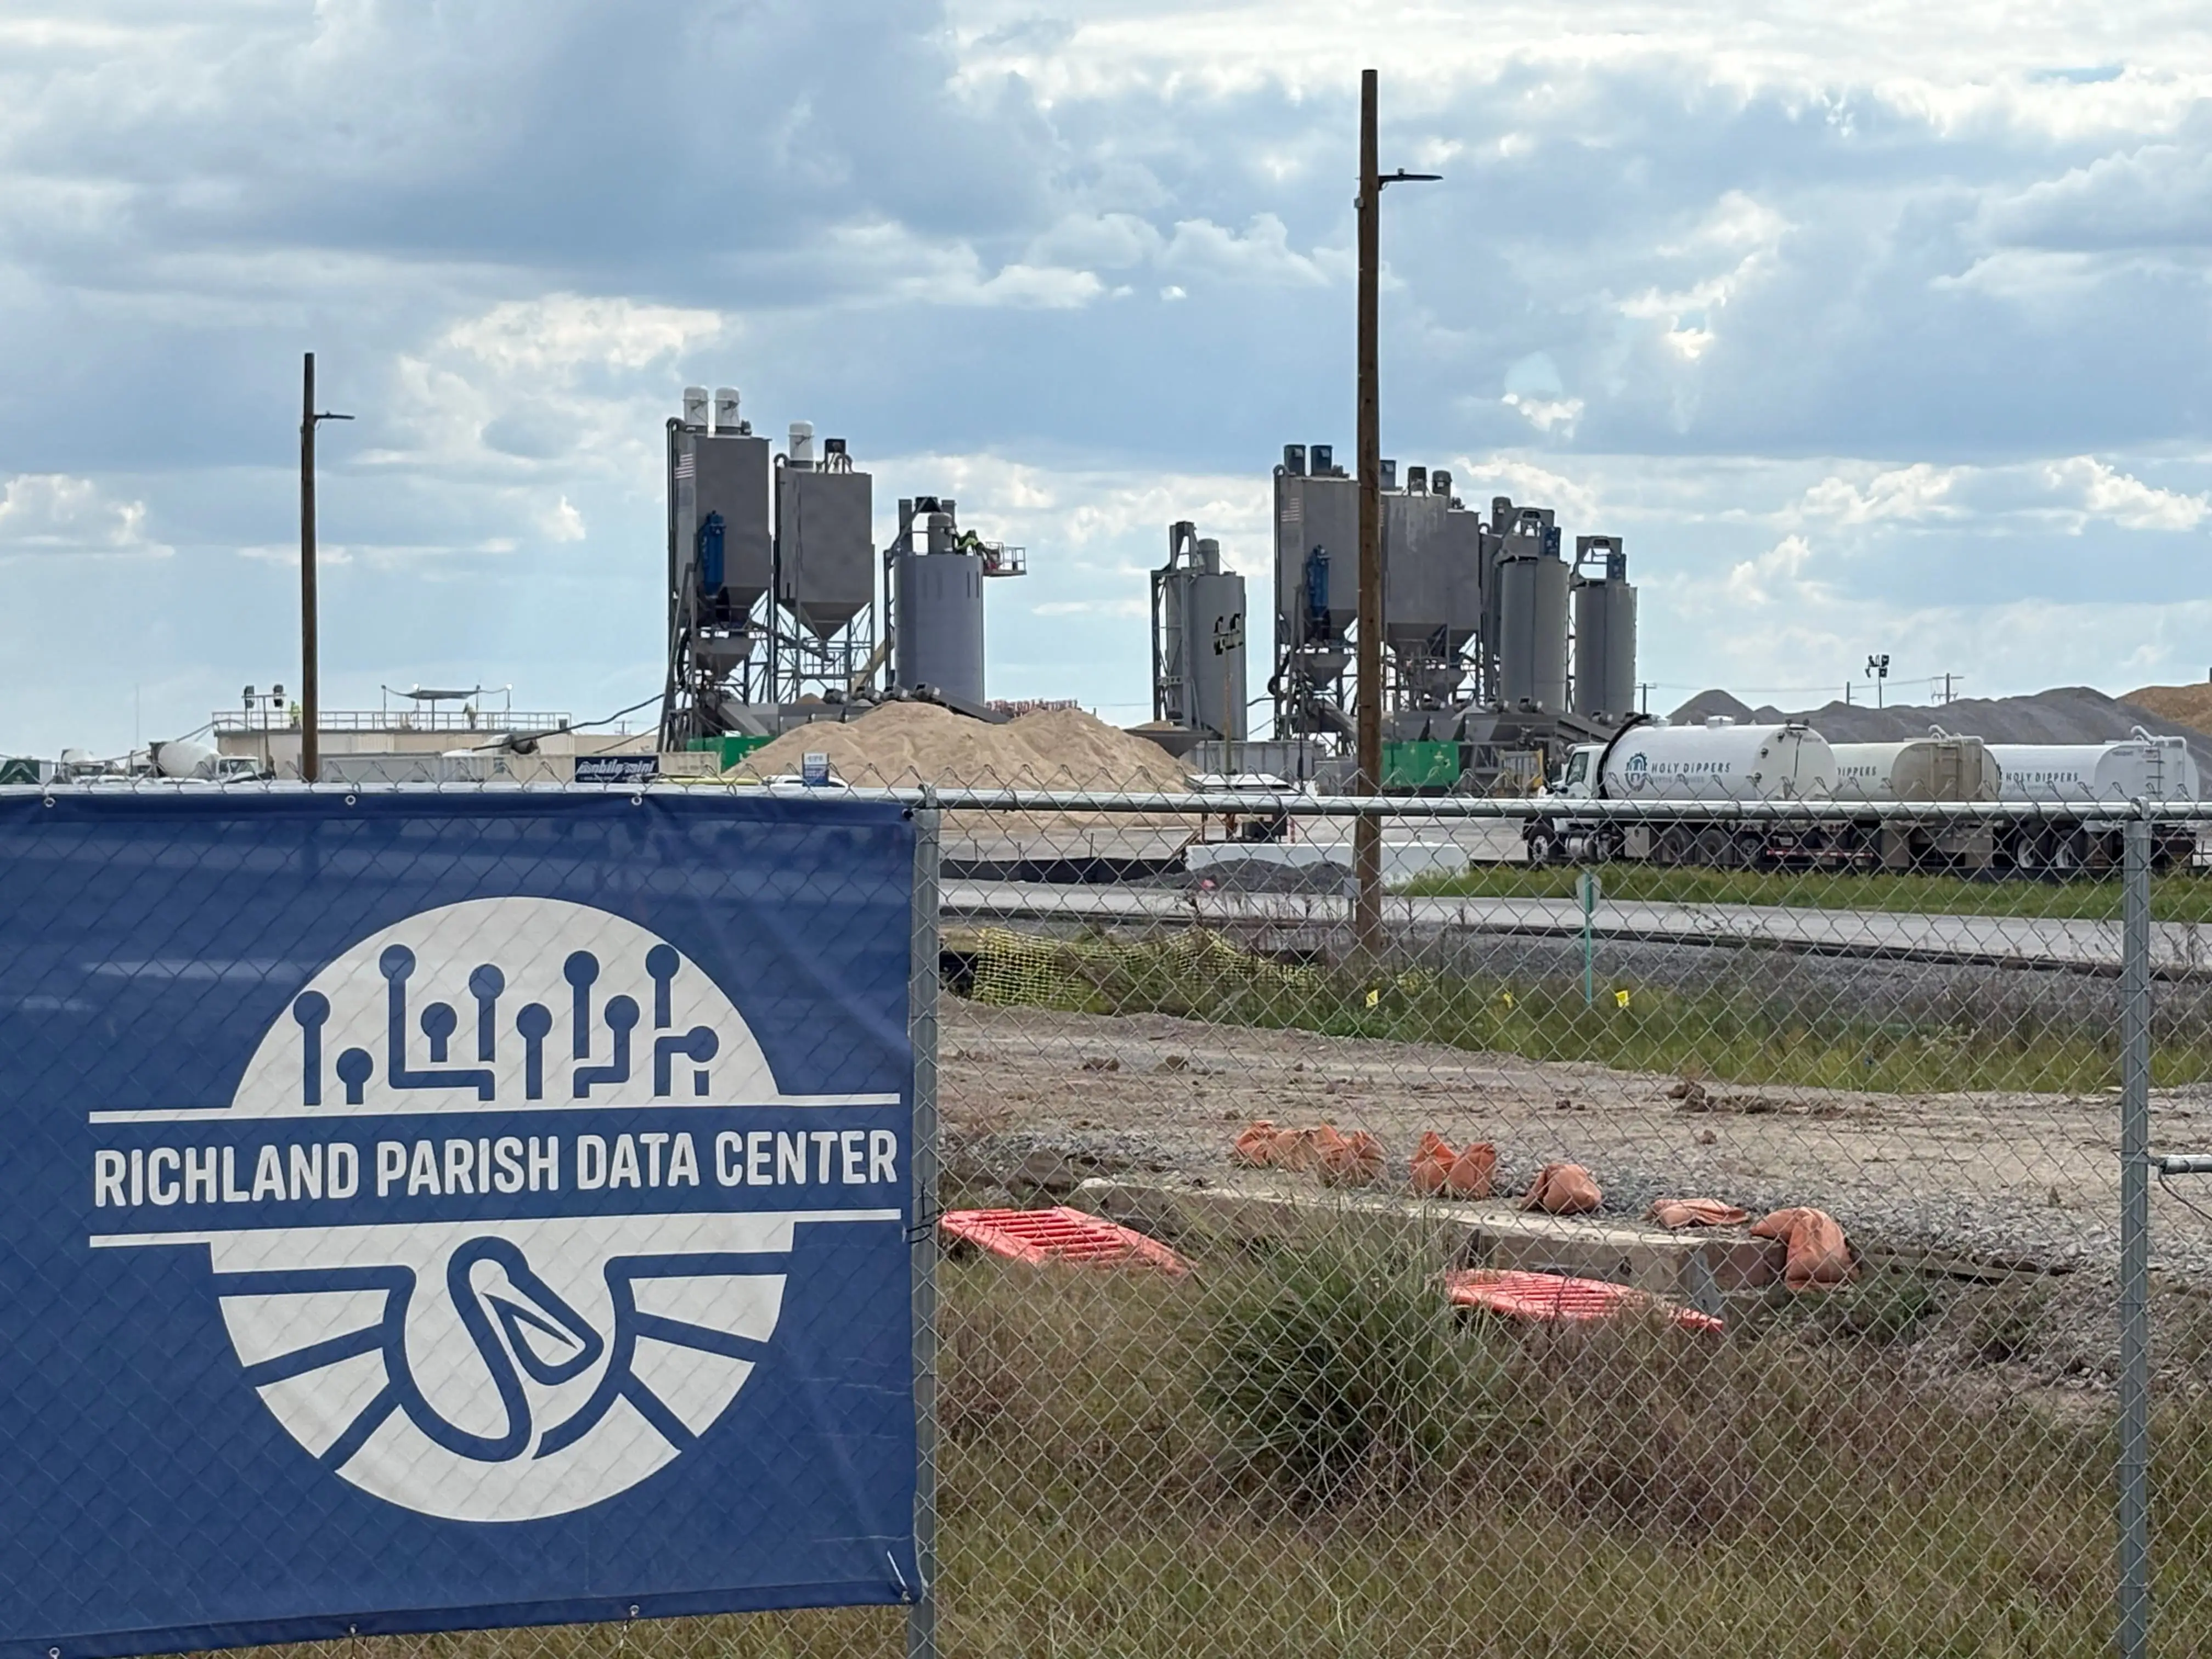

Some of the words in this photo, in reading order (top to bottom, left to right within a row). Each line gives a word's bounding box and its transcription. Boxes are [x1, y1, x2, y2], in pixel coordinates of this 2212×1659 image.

[1651, 762, 1679, 774] HOLY
[1683, 762, 1731, 774] DIPPERS
[2006, 772, 2032, 782] HOLY
[2035, 772, 2078, 782] DIPPERS
[94, 1142, 360, 1207] RICHLAND
[376, 1136, 560, 1198] PARISH
[577, 1131, 701, 1190] DATA
[714, 1129, 898, 1188] CENTER
